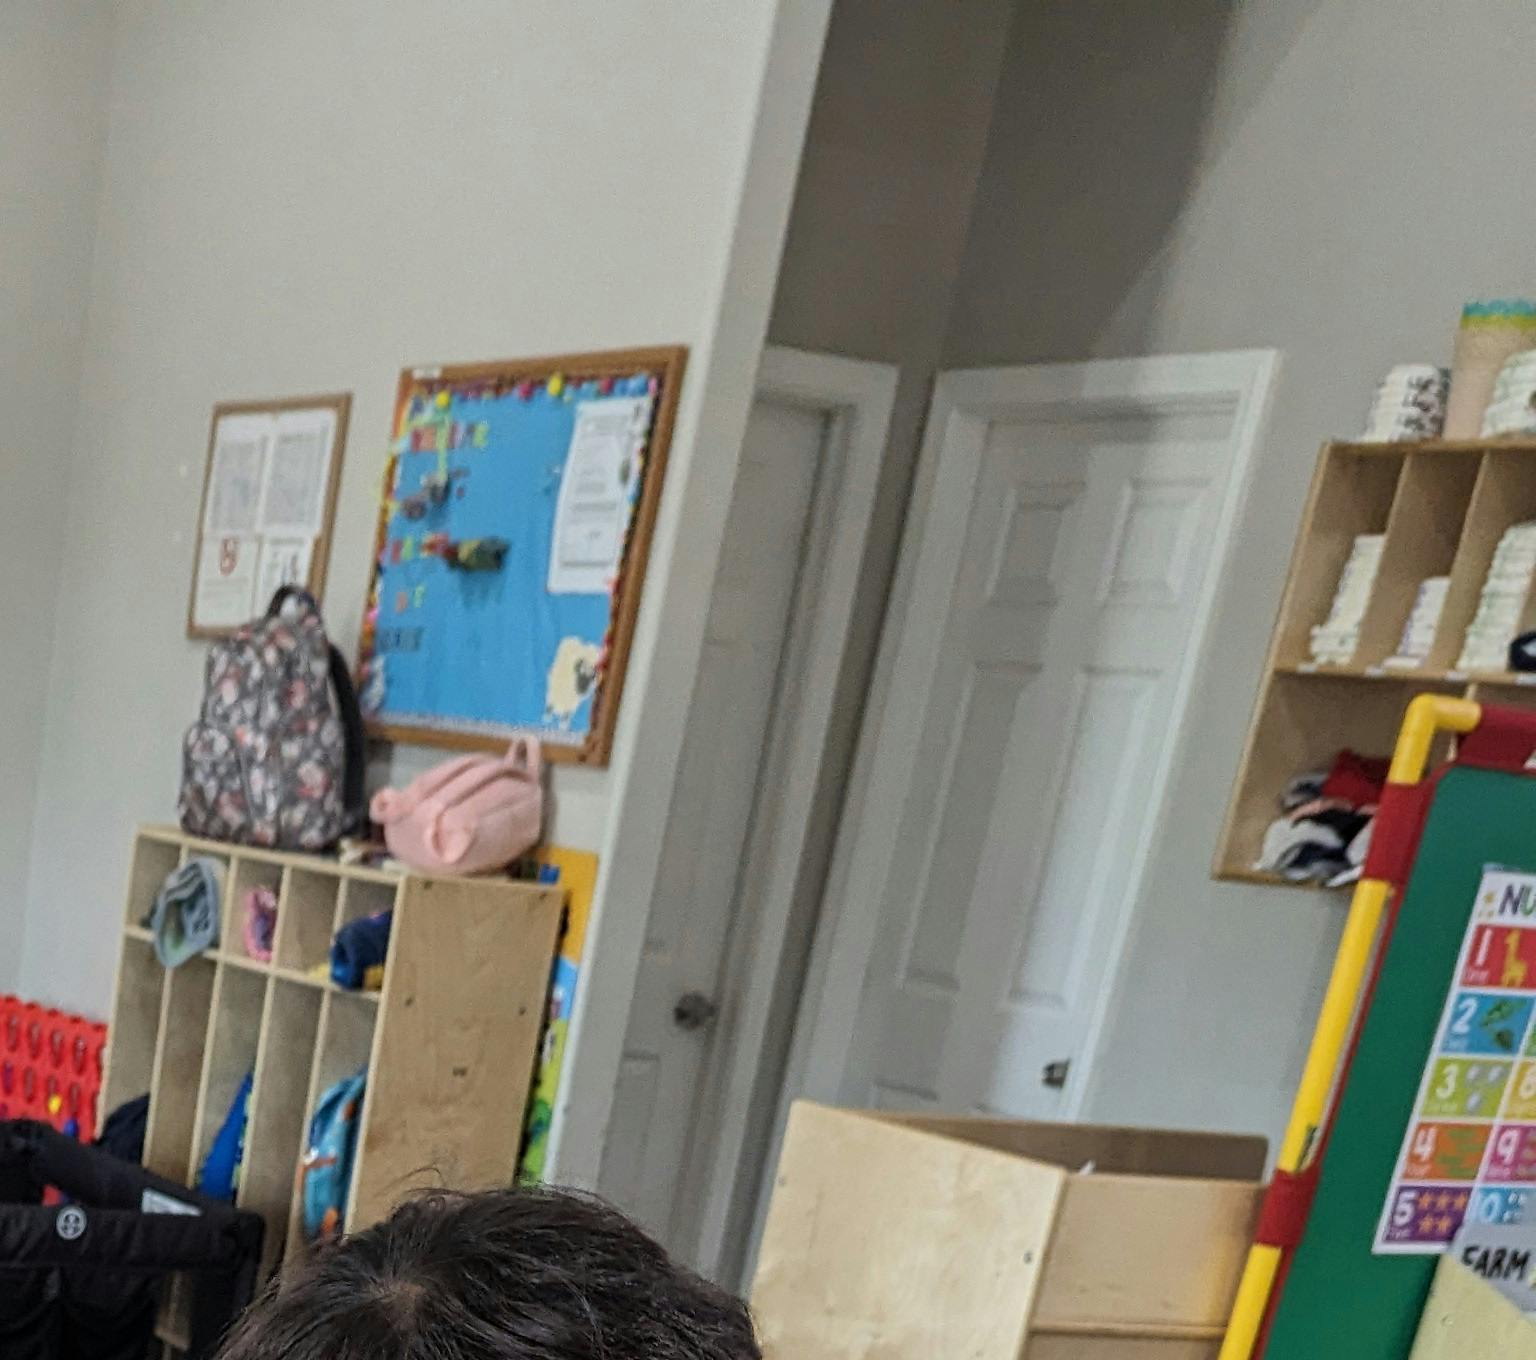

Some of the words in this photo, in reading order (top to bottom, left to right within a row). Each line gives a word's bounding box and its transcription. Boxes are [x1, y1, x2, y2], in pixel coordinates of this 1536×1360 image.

[1476, 928, 1493, 968] 1
[1451, 998, 1478, 1034] 2
[1435, 1063, 1460, 1099] 3
[1413, 1127, 1438, 1163] 4
[1497, 1129, 1520, 1166] 9
[1393, 1191, 1416, 1227] 5
[1461, 1246, 1531, 1280] FARM
